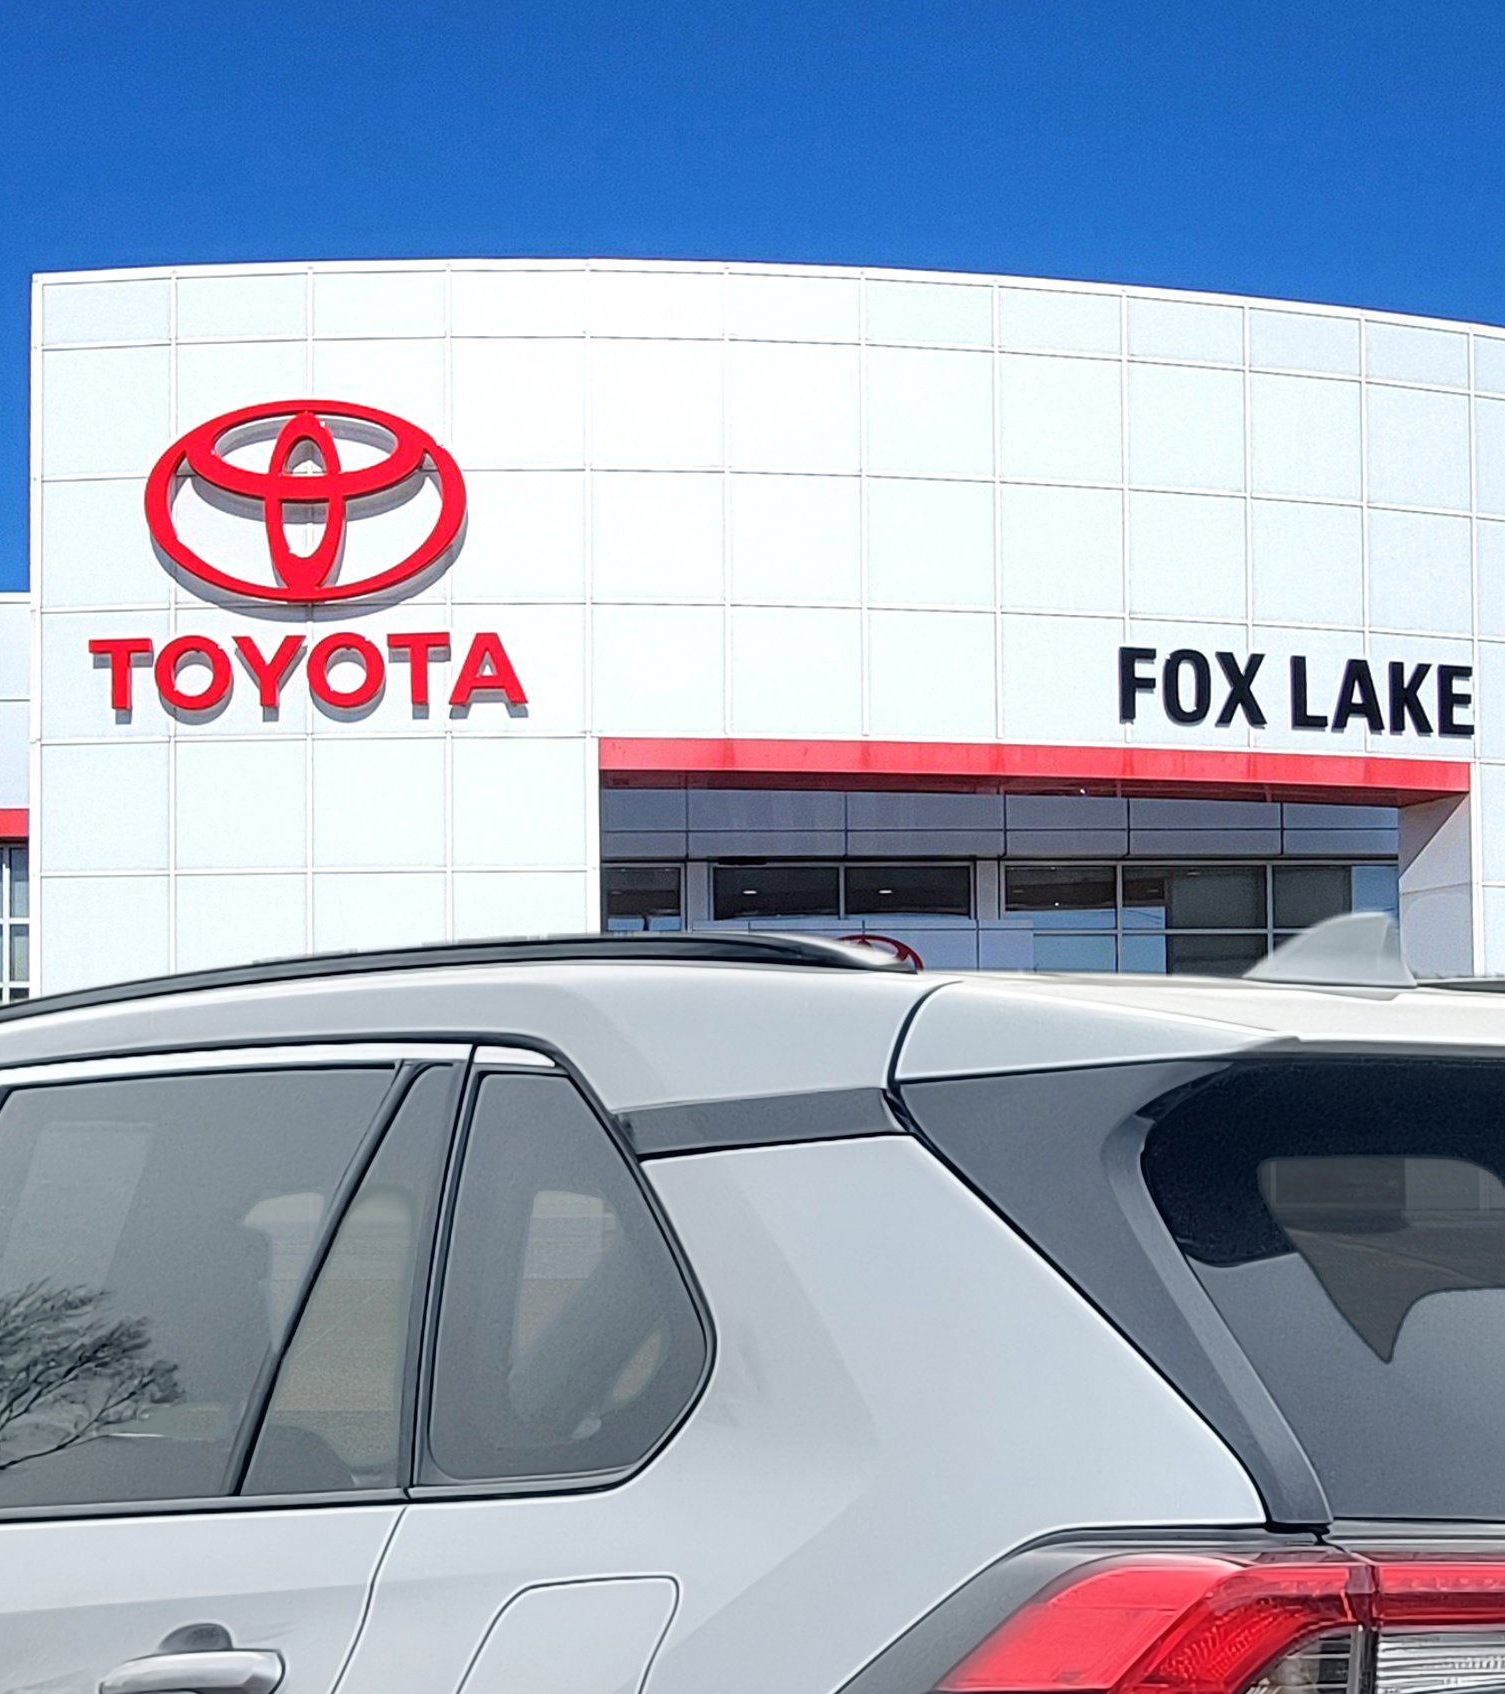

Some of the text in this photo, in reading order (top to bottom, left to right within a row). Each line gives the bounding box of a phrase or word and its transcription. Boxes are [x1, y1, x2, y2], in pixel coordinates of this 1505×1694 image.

[88, 631, 530, 725] TOYOTA
[1118, 646, 1476, 737] FOX LAKE
